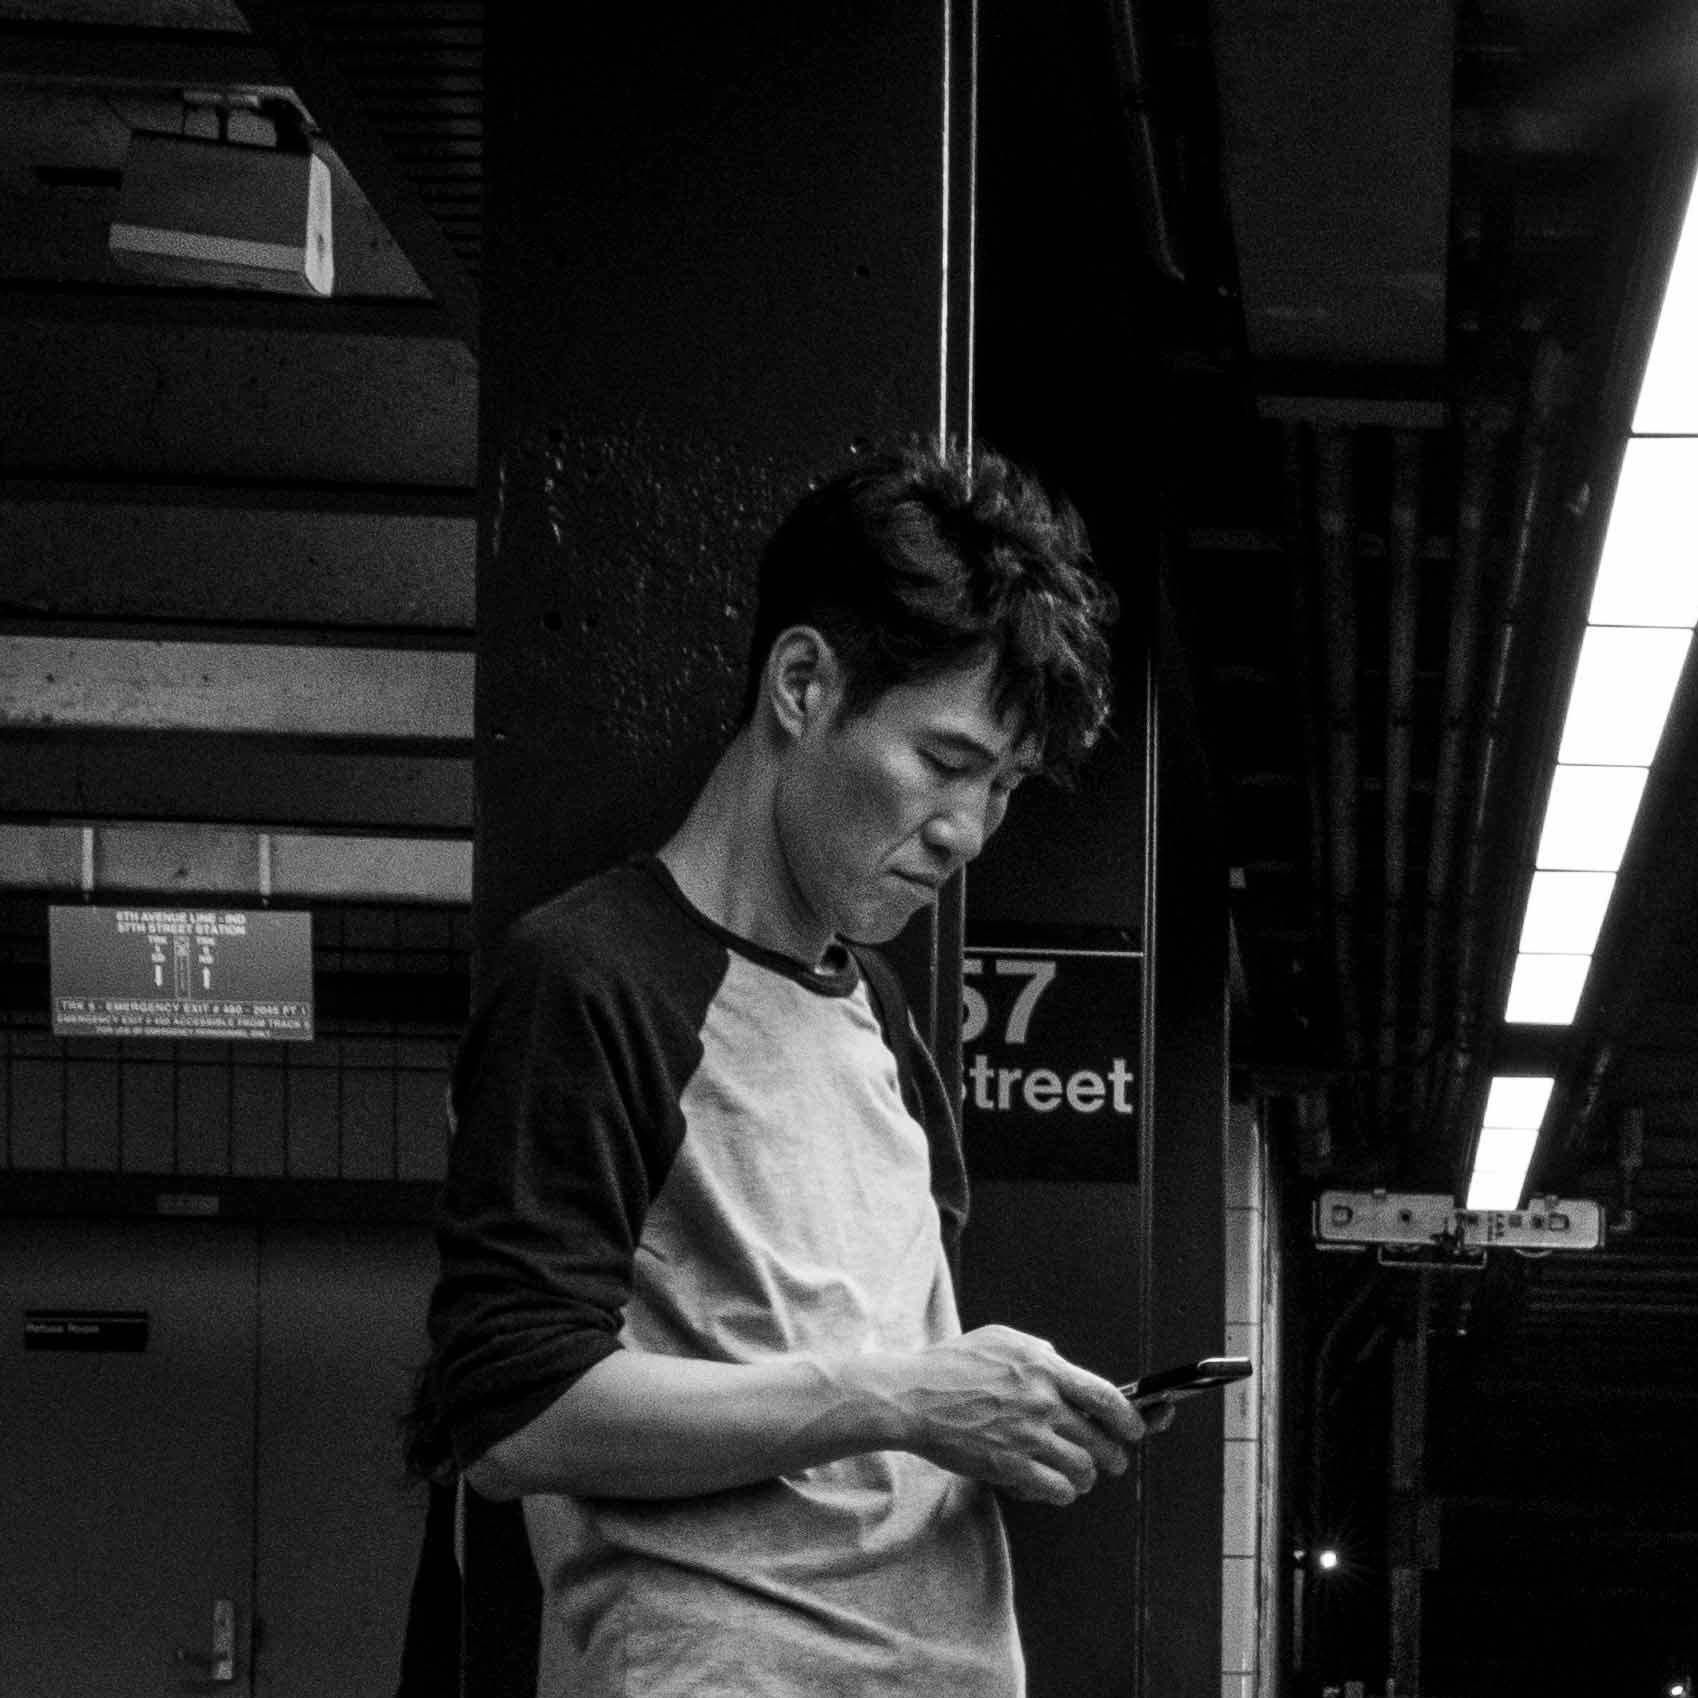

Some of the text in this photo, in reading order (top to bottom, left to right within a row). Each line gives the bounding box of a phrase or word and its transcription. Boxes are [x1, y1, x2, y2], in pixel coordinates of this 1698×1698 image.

[141, 911, 187, 923] AVENUE
[189, 912, 216, 924] LINE
[148, 922, 192, 935] STREET
[194, 923, 246, 935] STATION
[105, 1001, 180, 1013] EMERGENCY
[183, 1003, 209, 1014] EXIT
[961, 1053, 1134, 1115] treet
